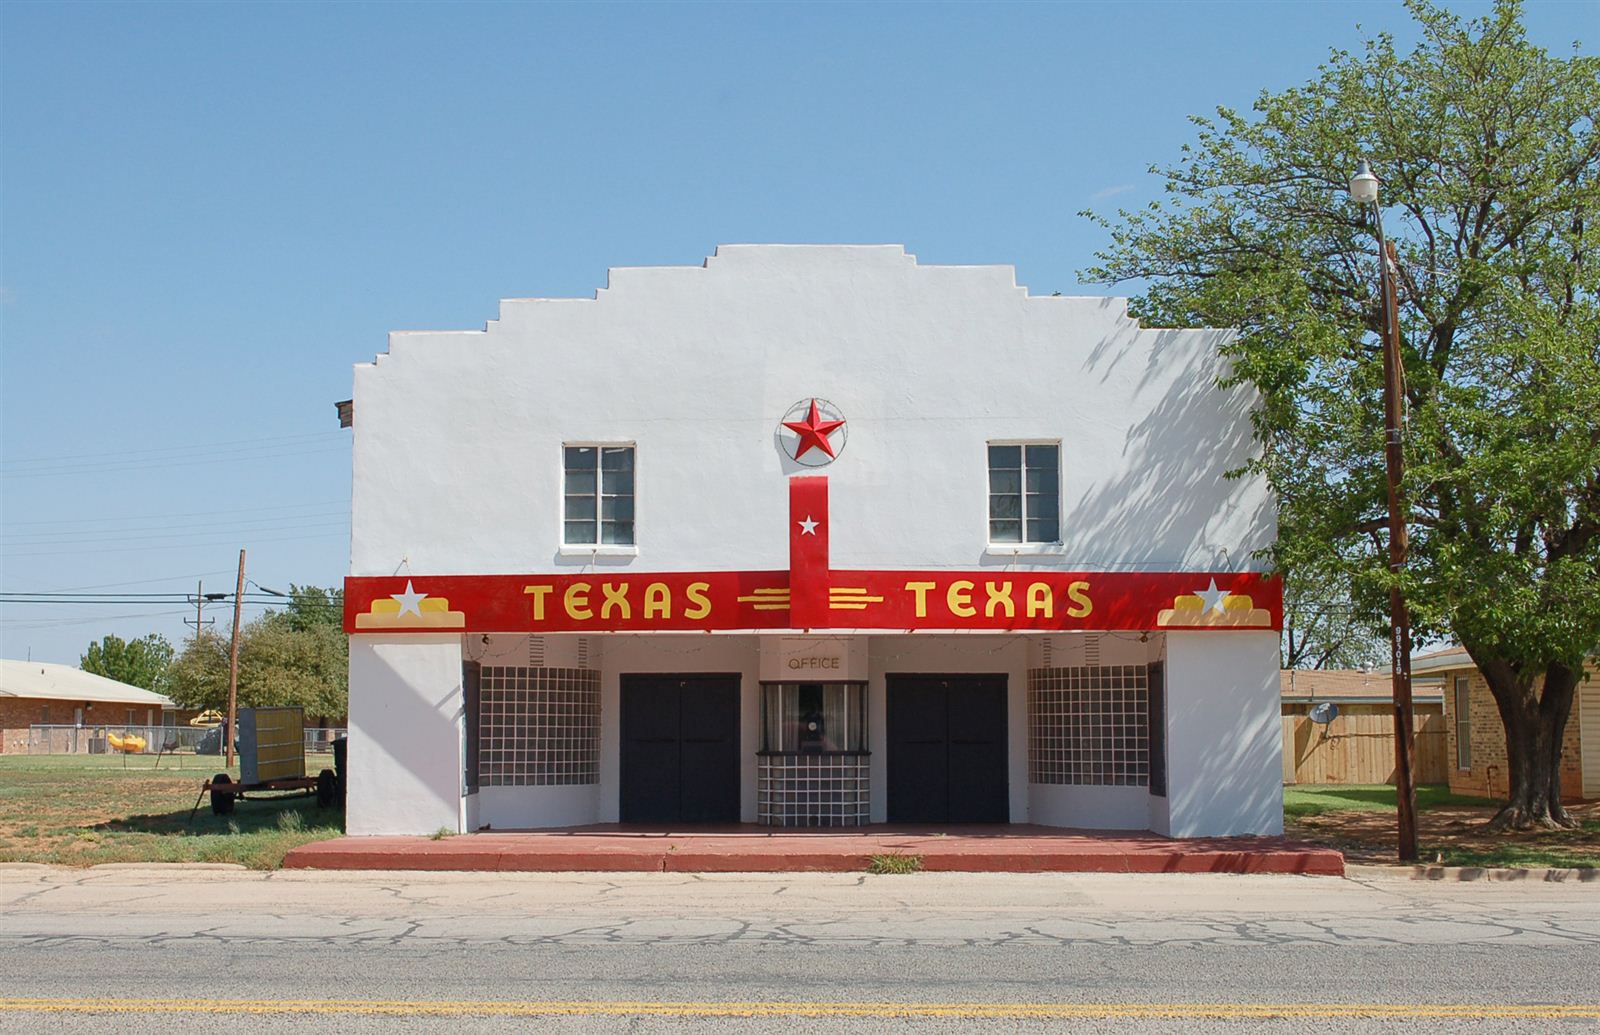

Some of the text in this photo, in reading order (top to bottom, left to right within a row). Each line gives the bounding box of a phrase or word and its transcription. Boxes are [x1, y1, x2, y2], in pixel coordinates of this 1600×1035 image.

[523, 582, 713, 621] TEXAS
[904, 580, 1094, 619] TEXAS
[788, 657, 840, 670] OFFICE
